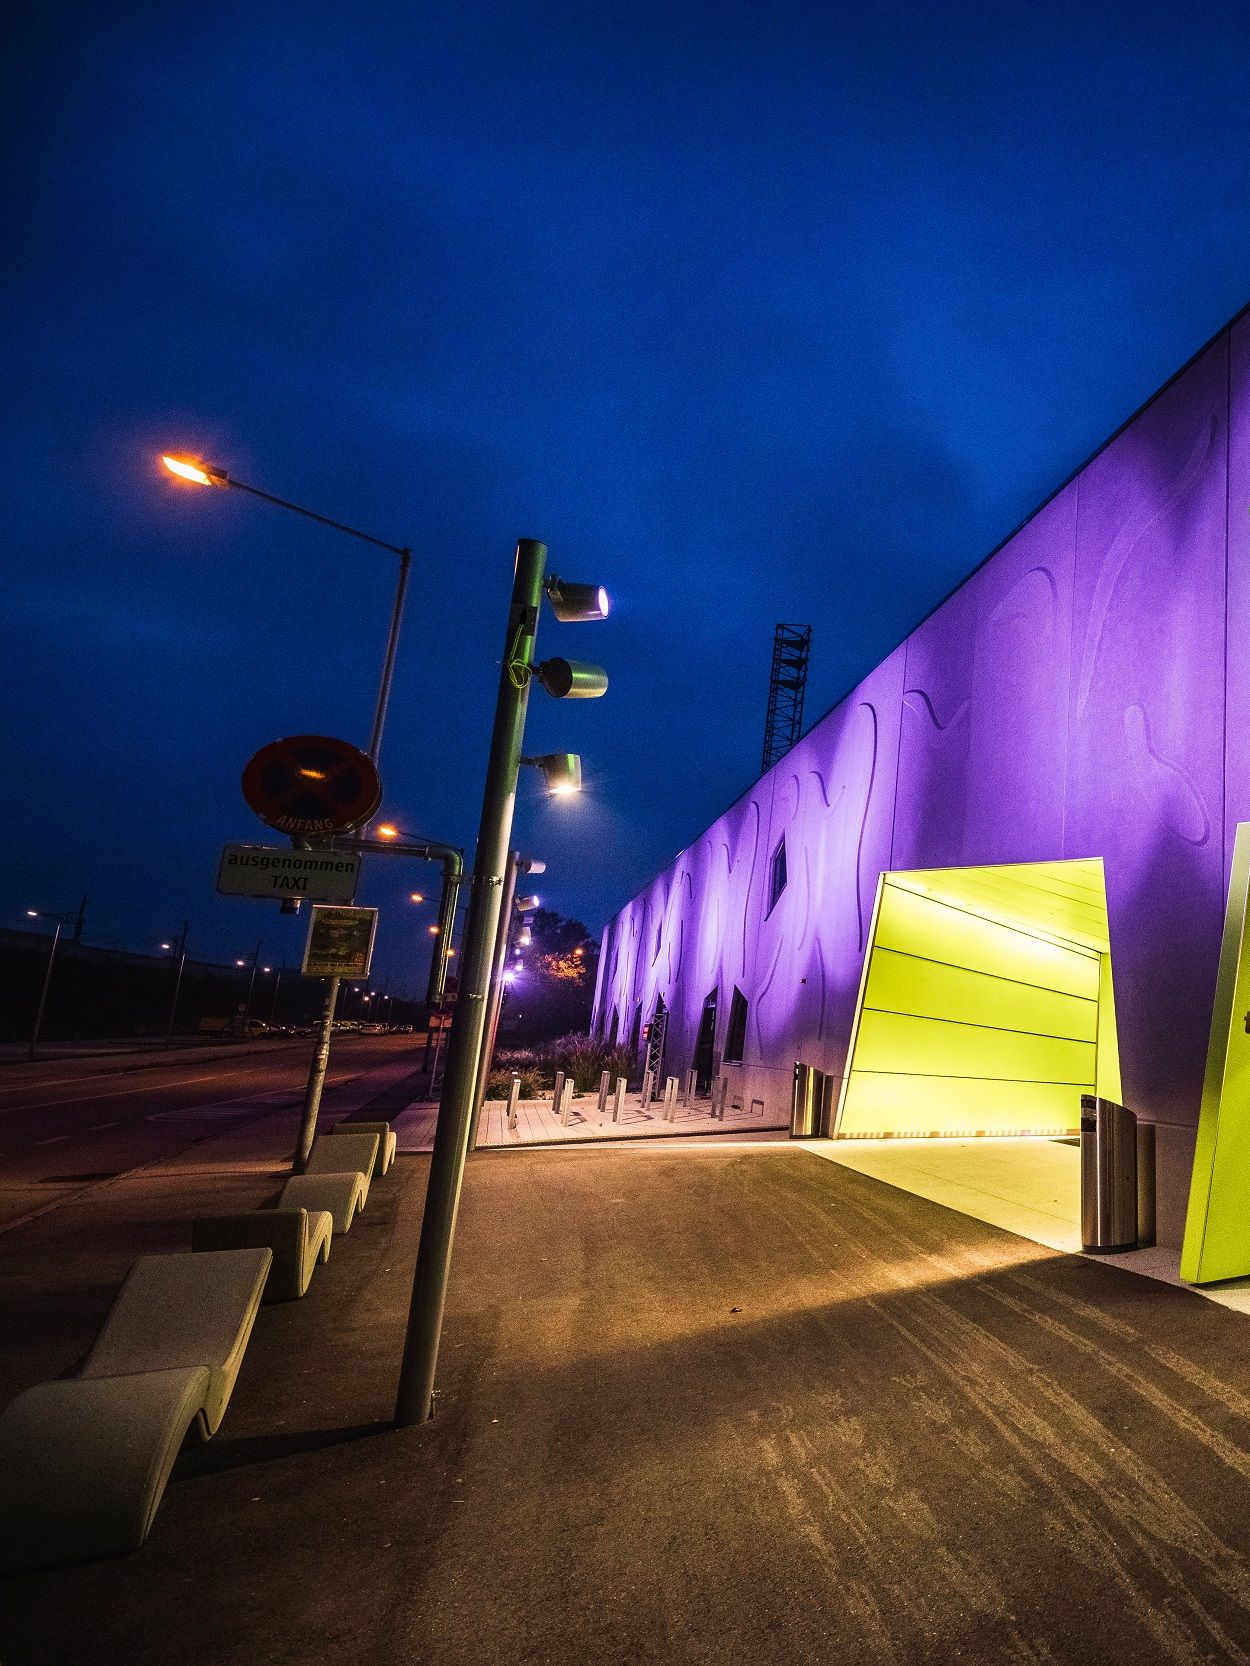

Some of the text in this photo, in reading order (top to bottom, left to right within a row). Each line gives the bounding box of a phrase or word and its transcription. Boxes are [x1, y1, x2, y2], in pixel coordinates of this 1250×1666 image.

[276, 815, 335, 831] ANFANG
[228, 854, 355, 873] ausgenommen
[271, 875, 309, 890] TAXI
